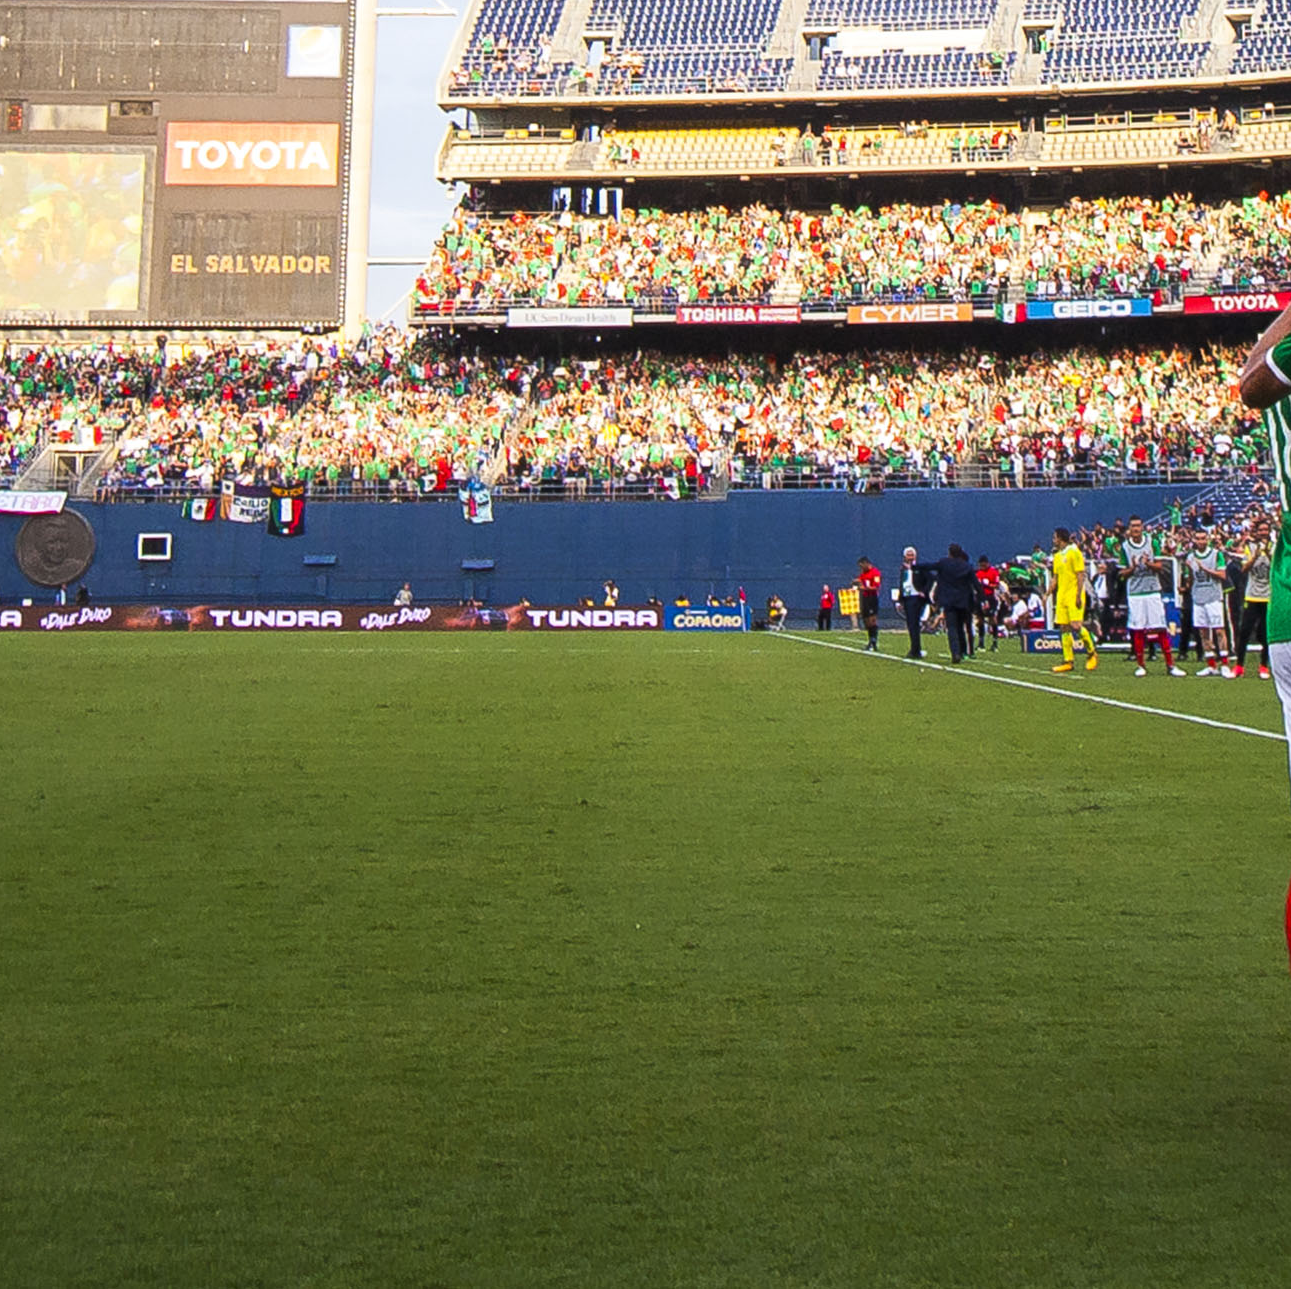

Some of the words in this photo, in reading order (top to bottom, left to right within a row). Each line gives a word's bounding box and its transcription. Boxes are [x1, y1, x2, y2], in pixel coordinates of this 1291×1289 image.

[174, 140, 330, 170] TOYOTA
[170, 254, 198, 273] EL
[206, 255, 332, 274] SALVADOR
[1053, 299, 1132, 318] GEICO
[1211, 293, 1278, 311] TOYOTA
[681, 308, 756, 323] TOSHIBA
[860, 305, 959, 322] CYMER
[78, 607, 112, 625] DURO
[210, 610, 343, 628] TUNDRA
[398, 607, 431, 625] DURO
[527, 610, 658, 628] TUNDRA
